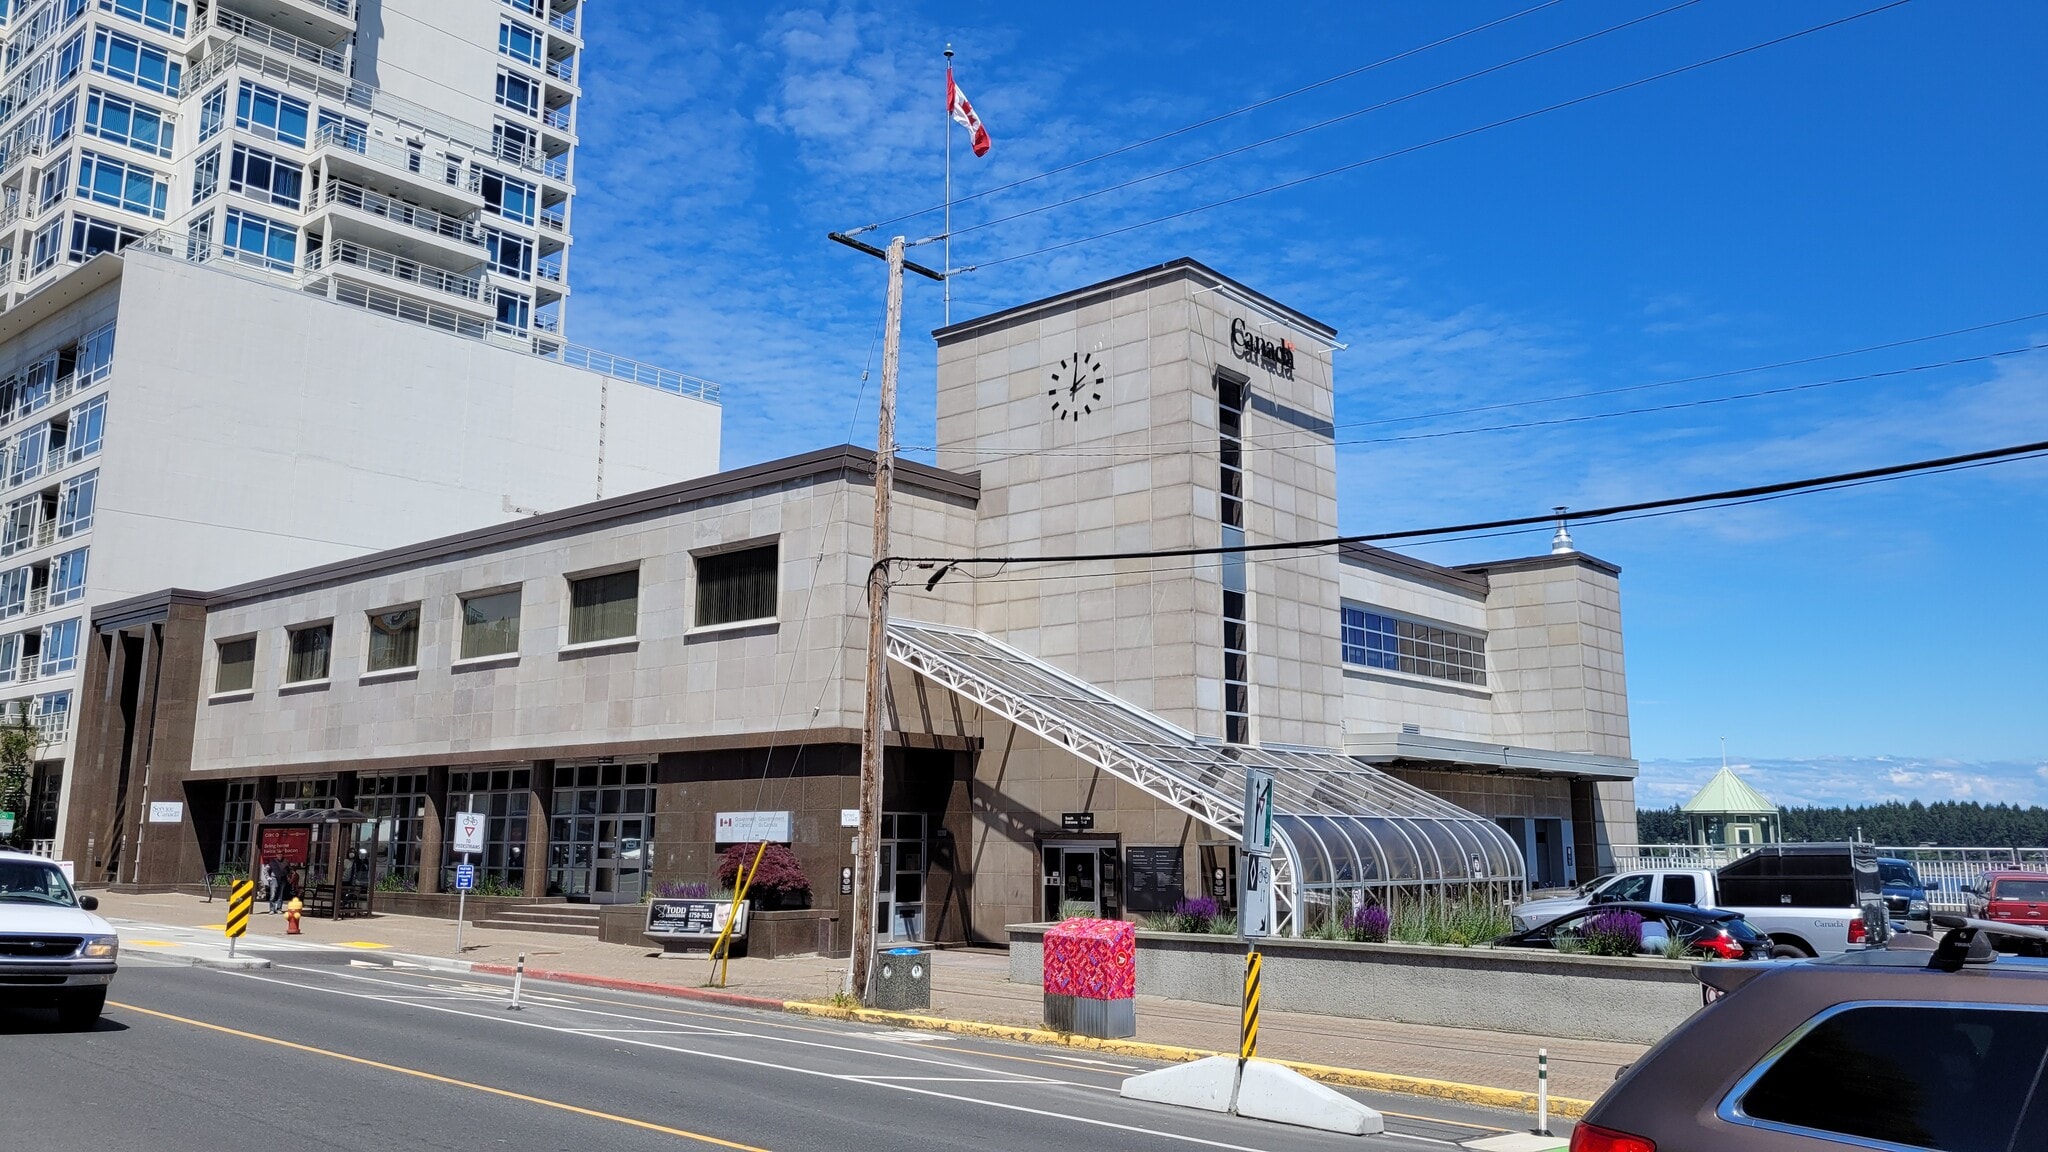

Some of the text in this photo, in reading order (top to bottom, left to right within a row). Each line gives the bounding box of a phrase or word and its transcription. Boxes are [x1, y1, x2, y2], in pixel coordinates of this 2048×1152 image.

[1231, 317, 1295, 369] Canada
[667, 906, 687, 914] TODD
[1814, 920, 1844, 928] Canada
